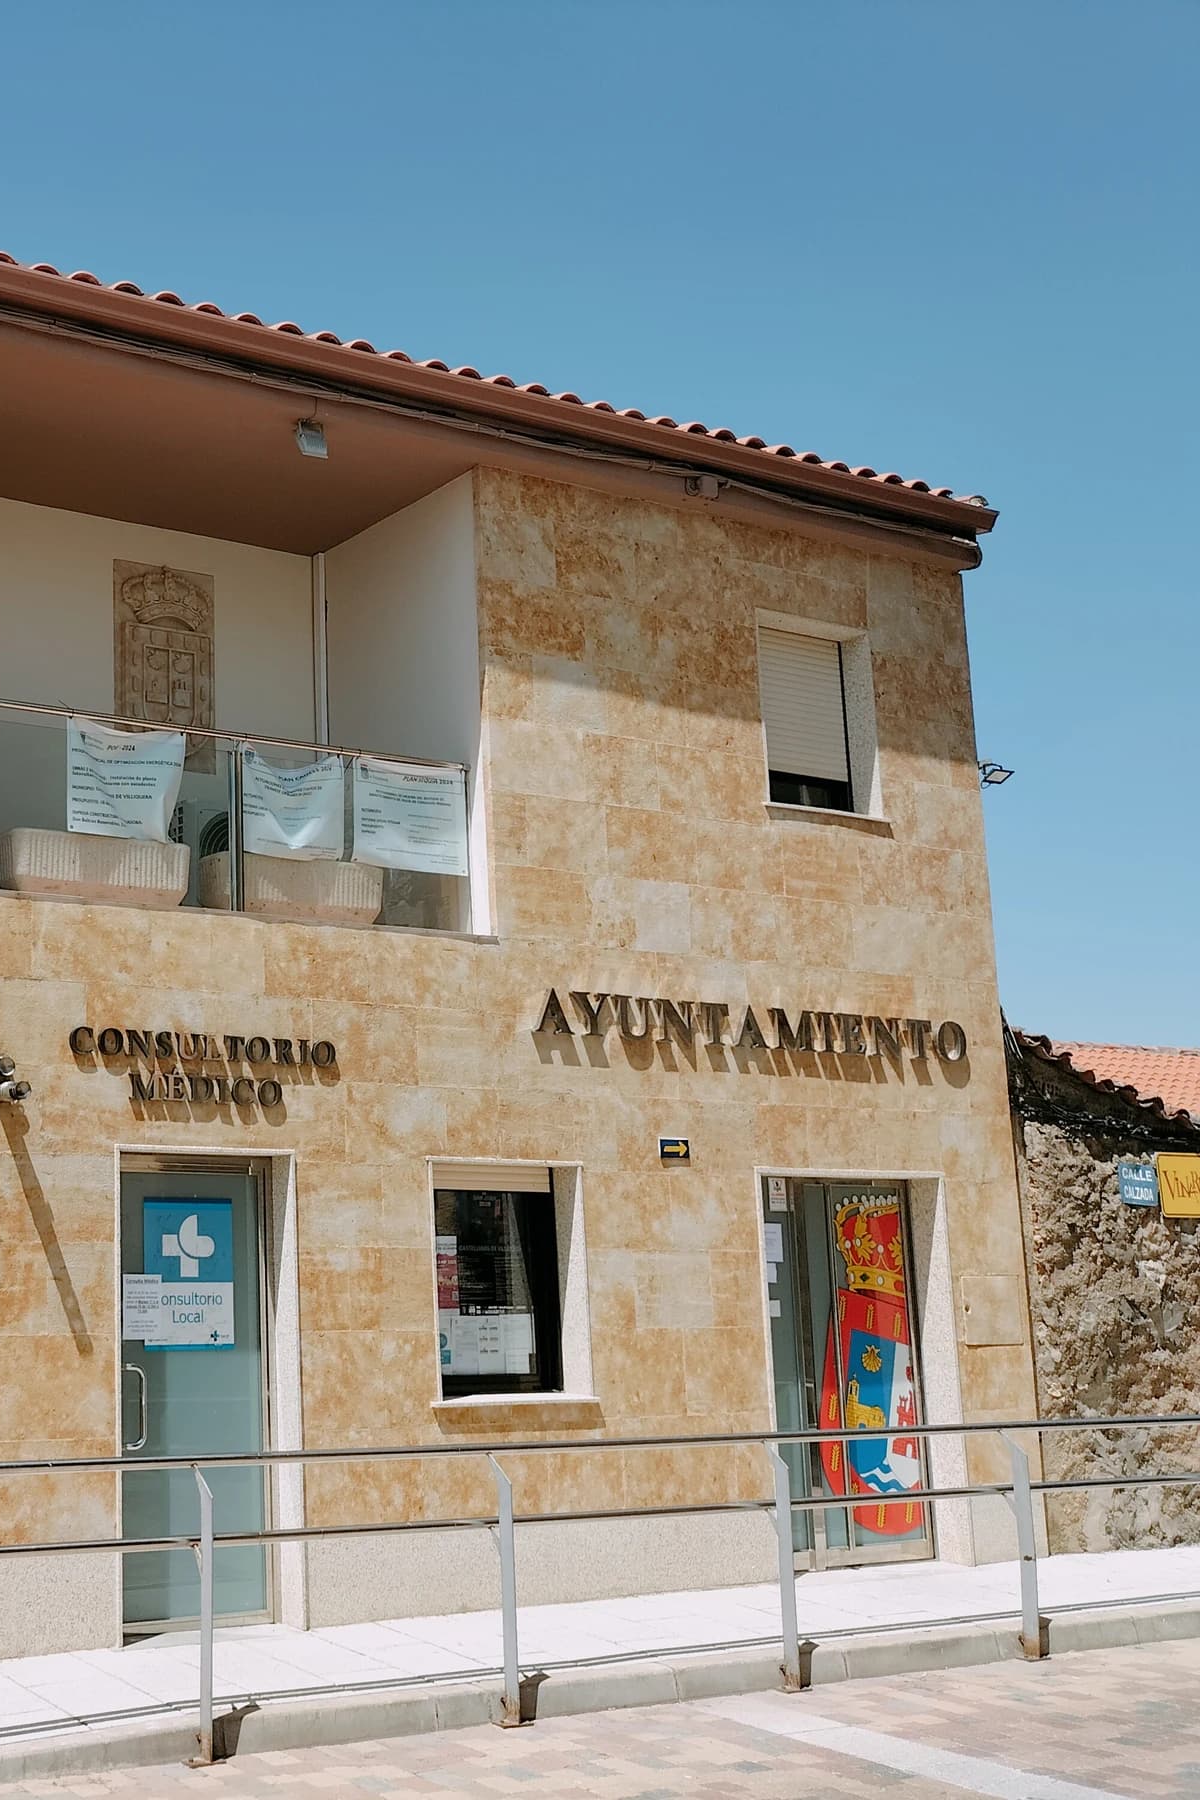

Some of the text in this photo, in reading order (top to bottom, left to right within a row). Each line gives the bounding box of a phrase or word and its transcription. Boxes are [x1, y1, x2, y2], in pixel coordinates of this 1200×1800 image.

[535, 987, 967, 1063] AYUNTAMIENTO
[69, 1026, 336, 1068] CONSULTORIO
[129, 1067, 283, 1107] MÉDICO
[1122, 1168, 1152, 1182] CALLE
[1124, 1185, 1154, 1201] CALZADA
[161, 1292, 223, 1306] onsultorio
[172, 1309, 204, 1324] Local
